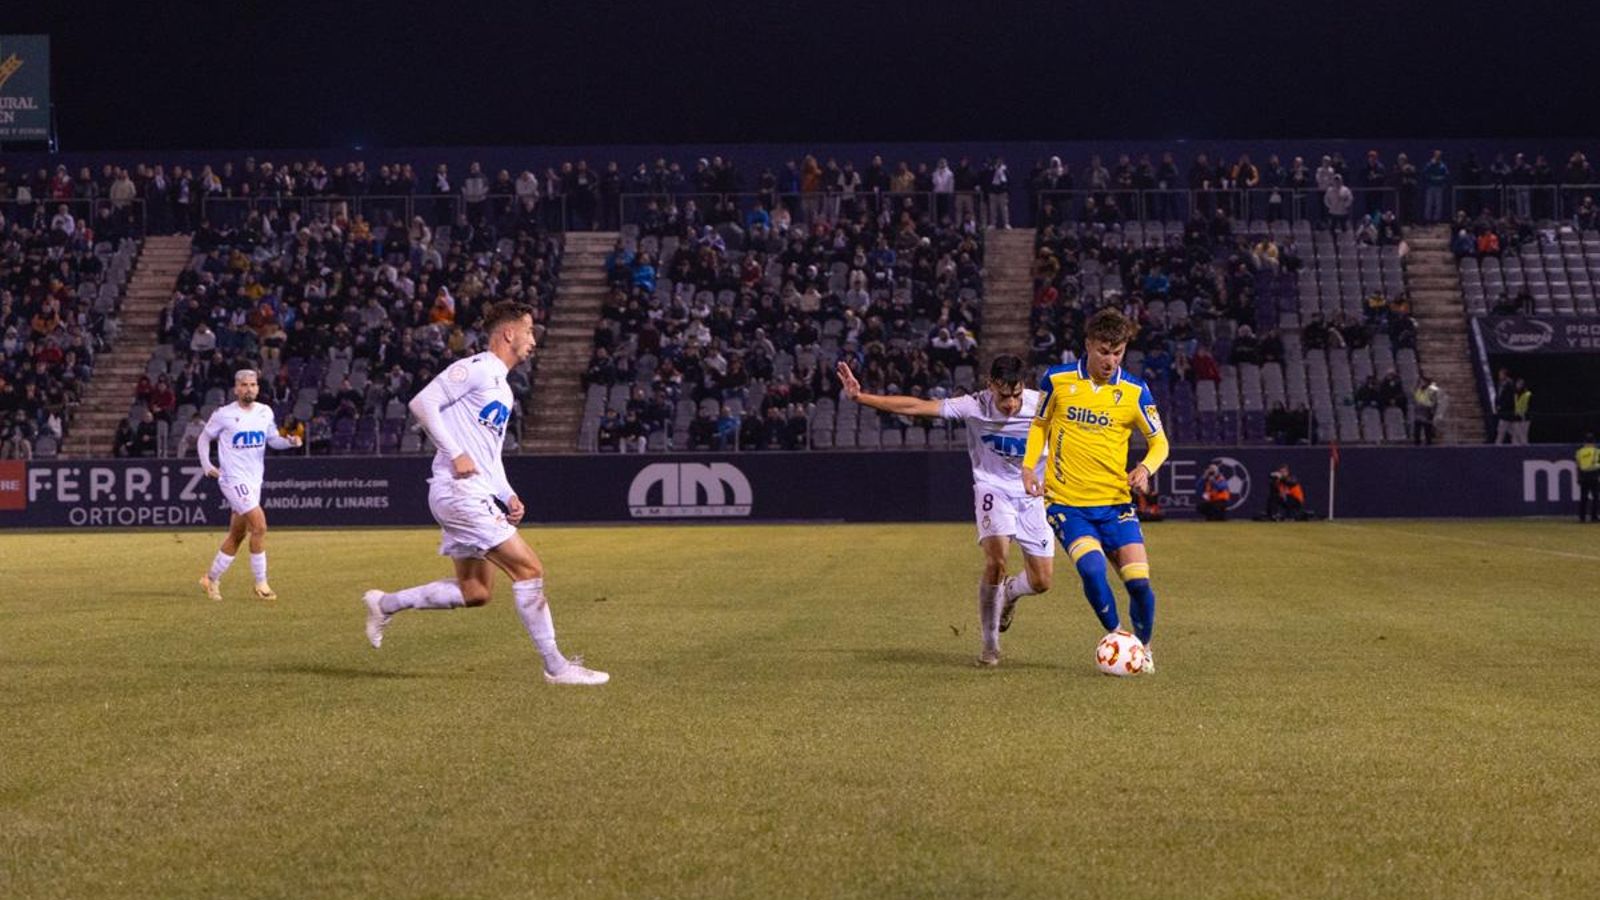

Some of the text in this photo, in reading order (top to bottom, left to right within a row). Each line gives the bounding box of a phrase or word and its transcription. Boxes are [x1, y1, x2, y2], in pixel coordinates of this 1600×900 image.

[234, 482, 250, 498] 10
[263, 494, 323, 508] ANDÚJAR
[336, 496, 389, 508] LINARES
[982, 493, 994, 512] 8
[69, 507, 207, 525] ORTOPEDIA
